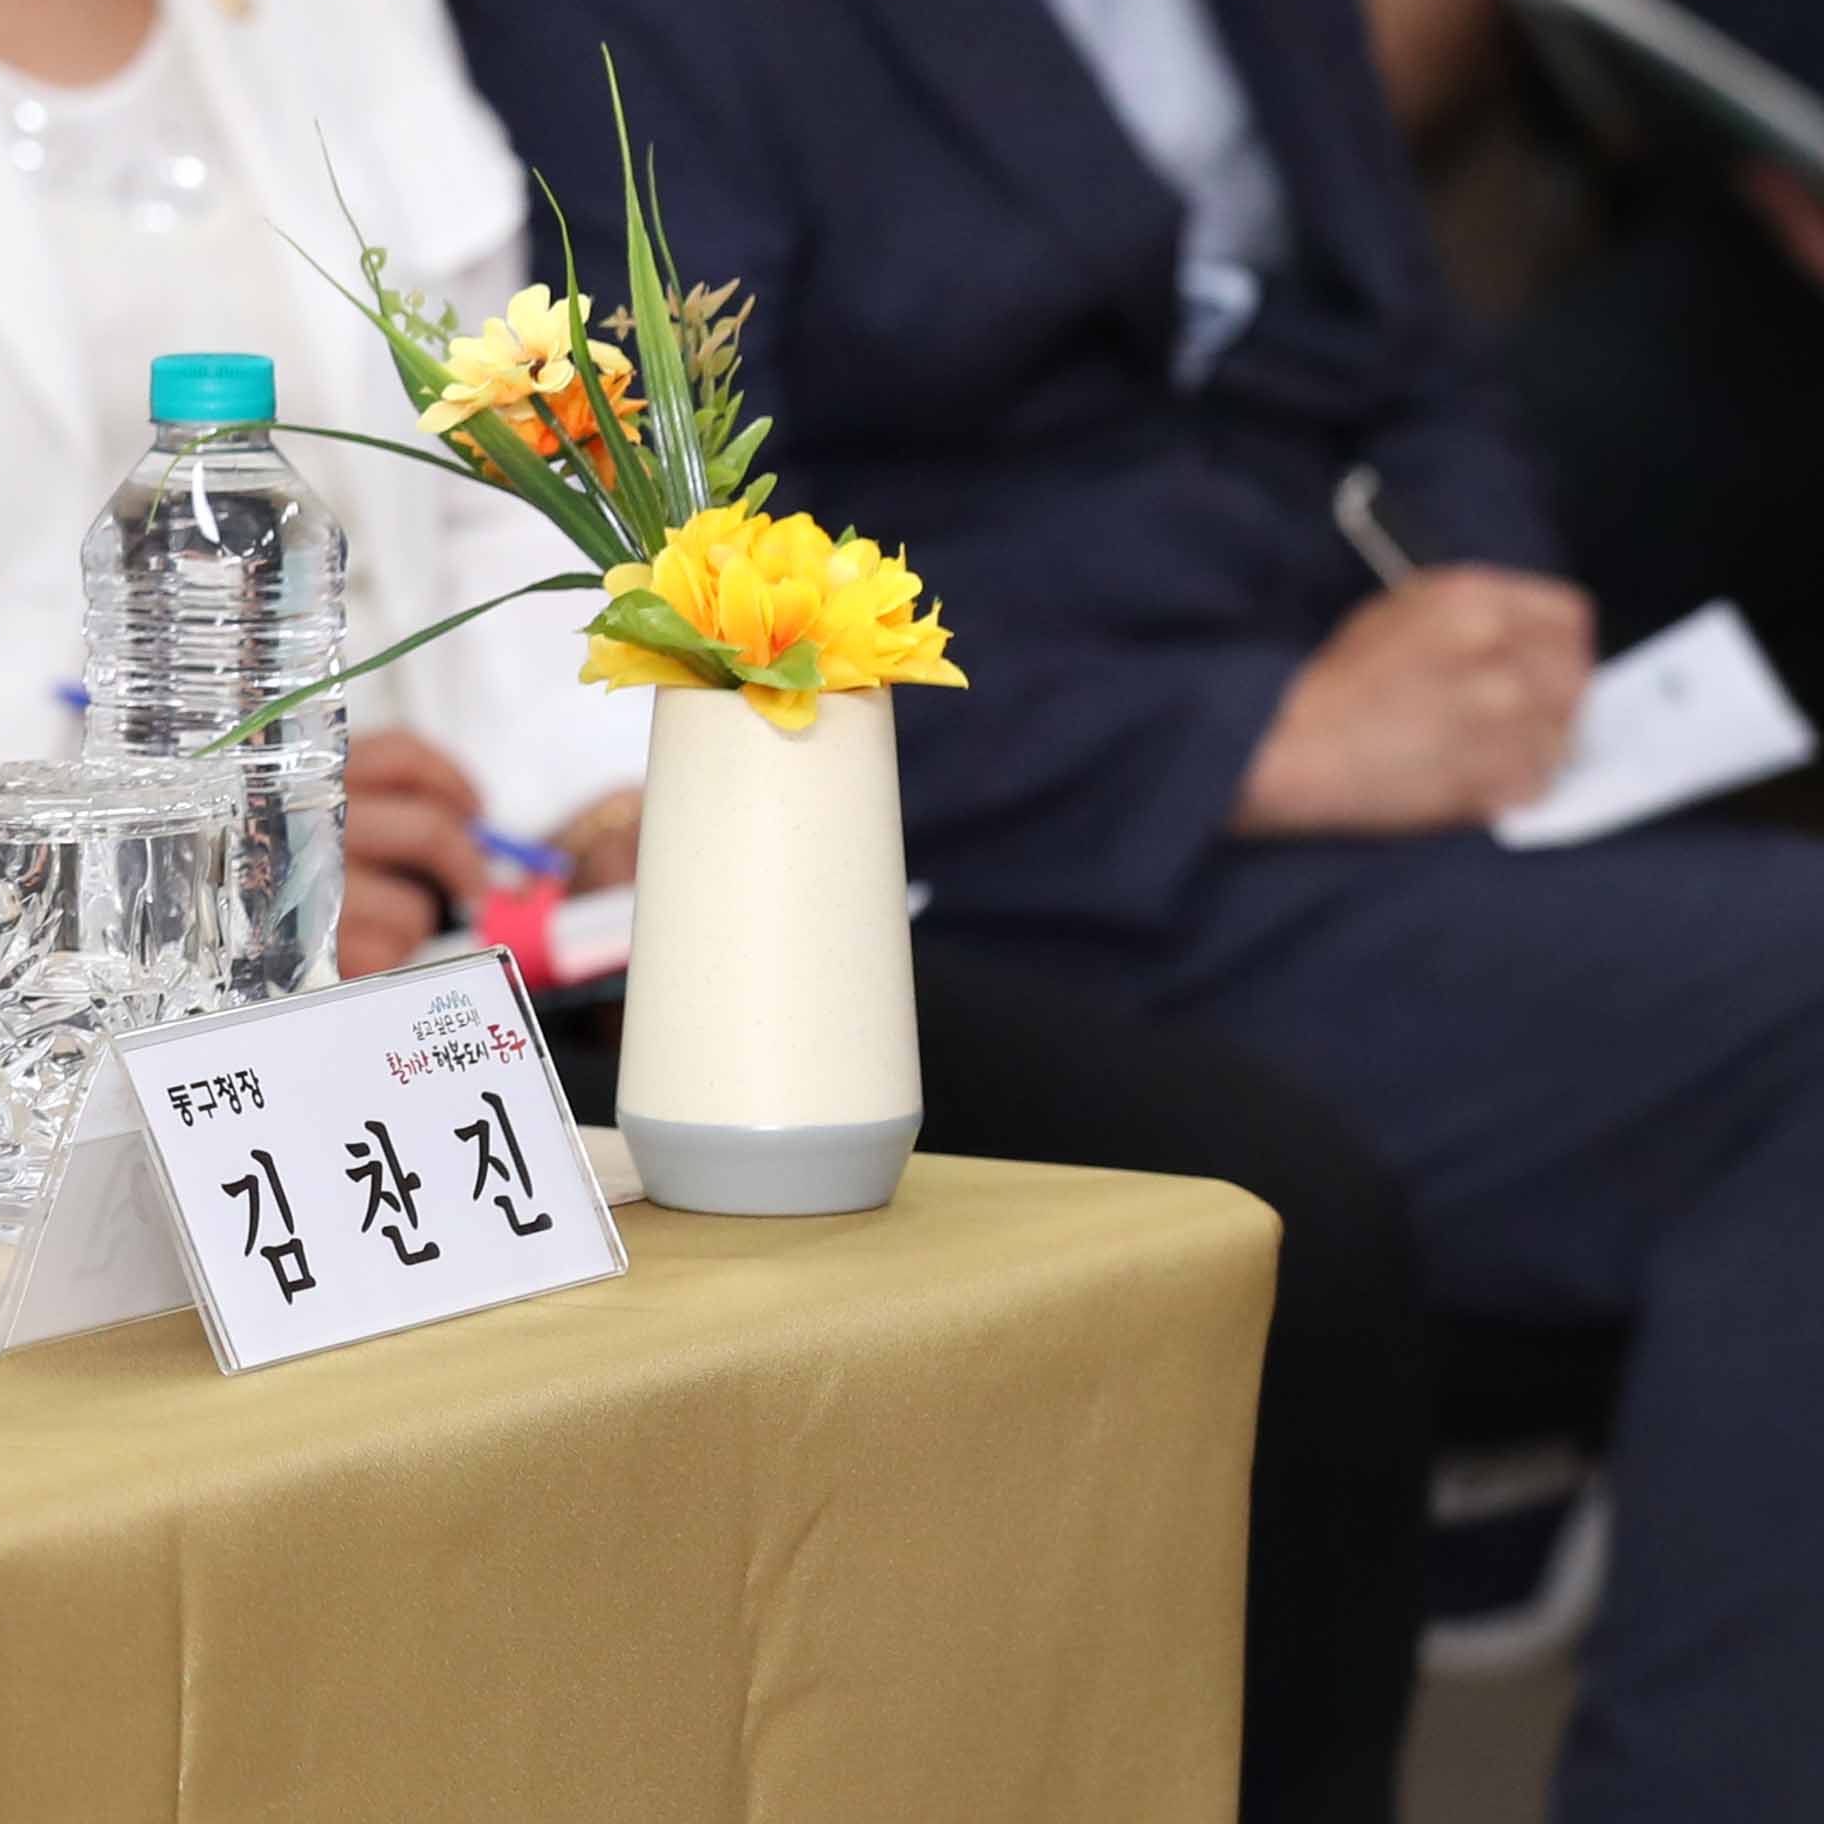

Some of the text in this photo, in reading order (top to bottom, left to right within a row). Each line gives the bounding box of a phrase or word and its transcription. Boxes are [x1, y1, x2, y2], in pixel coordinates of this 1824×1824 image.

[385, 1050, 433, 1085] 활기찬
[487, 1024, 528, 1065] 동구
[166, 1067, 265, 1127] 동구청장
